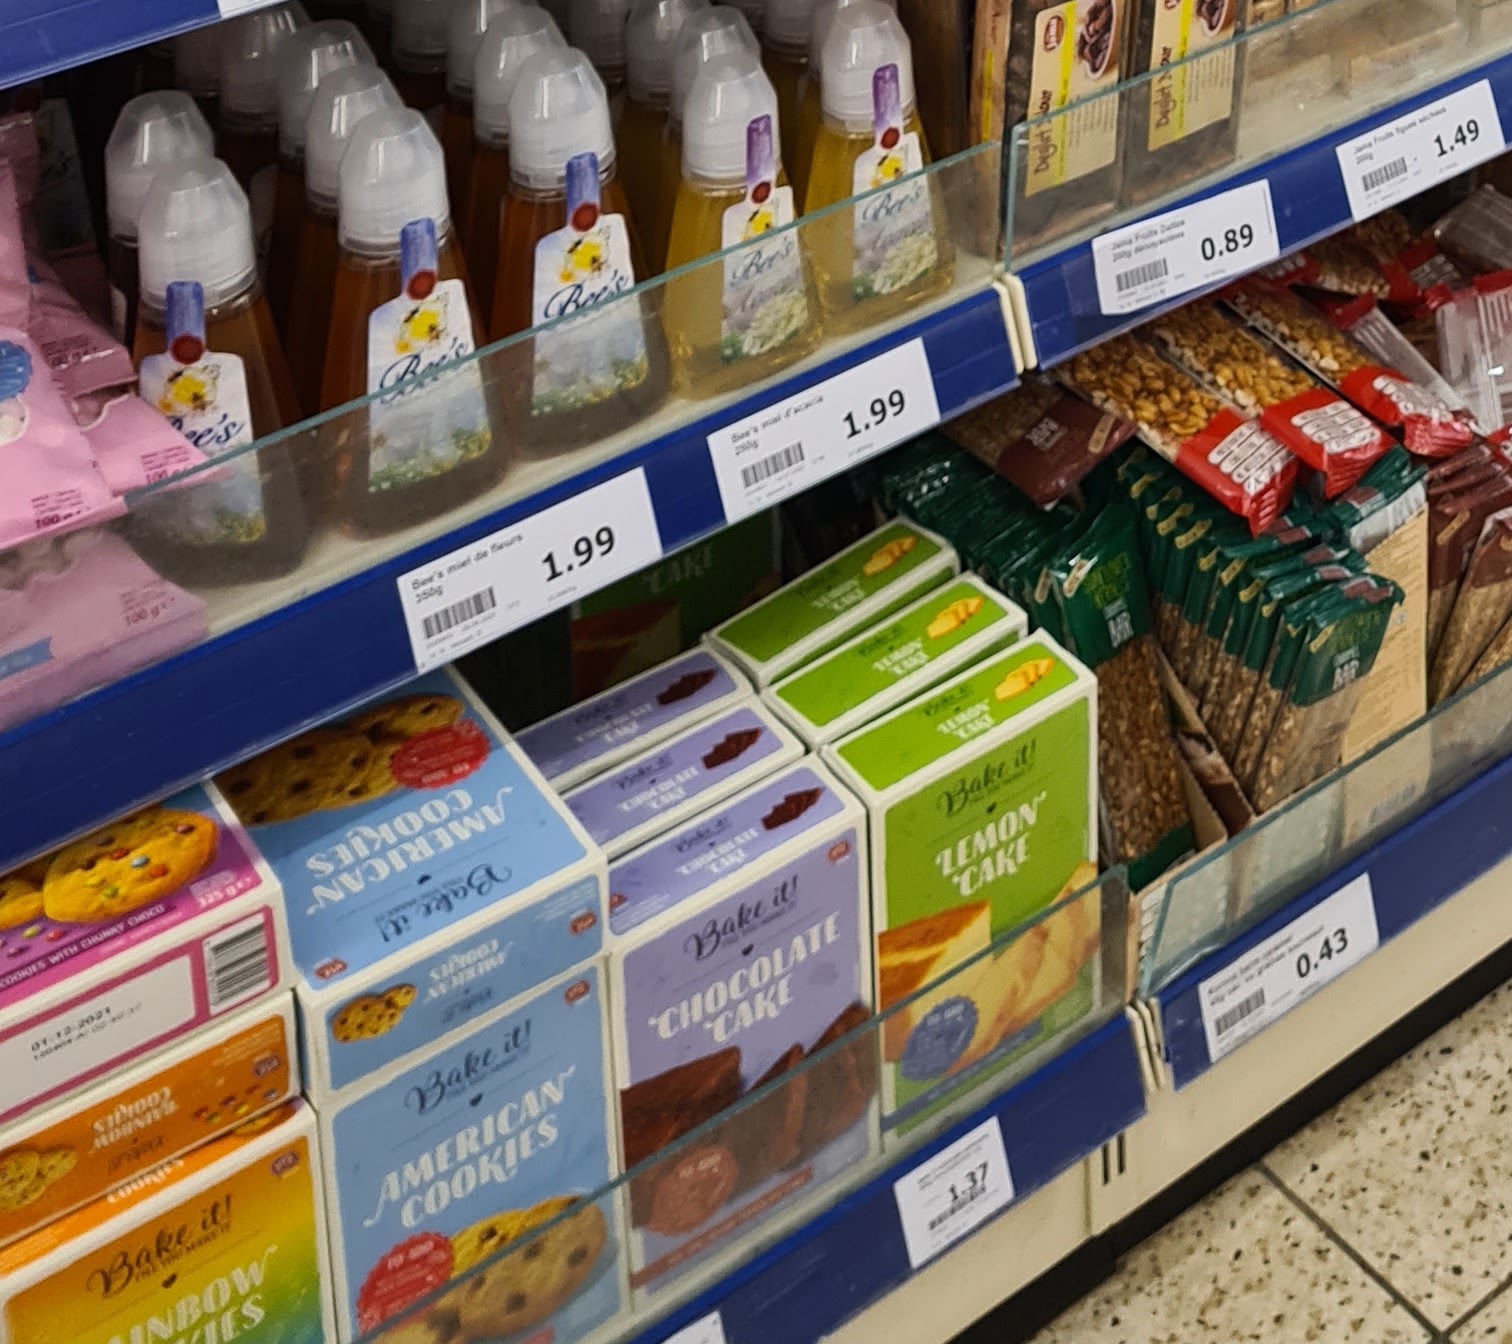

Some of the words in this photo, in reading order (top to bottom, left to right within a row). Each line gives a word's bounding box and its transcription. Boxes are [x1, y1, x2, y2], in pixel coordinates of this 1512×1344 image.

[1433, 119, 1482, 159] 1.49
[1201, 223, 1254, 262] 0.89
[841, 388, 906, 442] 1.99
[541, 525, 616, 583] 1.99
[936, 792, 1046, 878] LEMON
[951, 841, 1031, 896] CAKE
[683, 894, 758, 964] Bake
[1296, 927, 1350, 980] 0.43
[648, 912, 842, 1043] CHOCOLATE
[703, 984, 795, 1047] CAKE
[404, 1039, 494, 1114] Bake
[401, 1115, 562, 1228] COOKIES
[946, 1160, 990, 1203] 1.37
[86, 1221, 188, 1299] Bake
